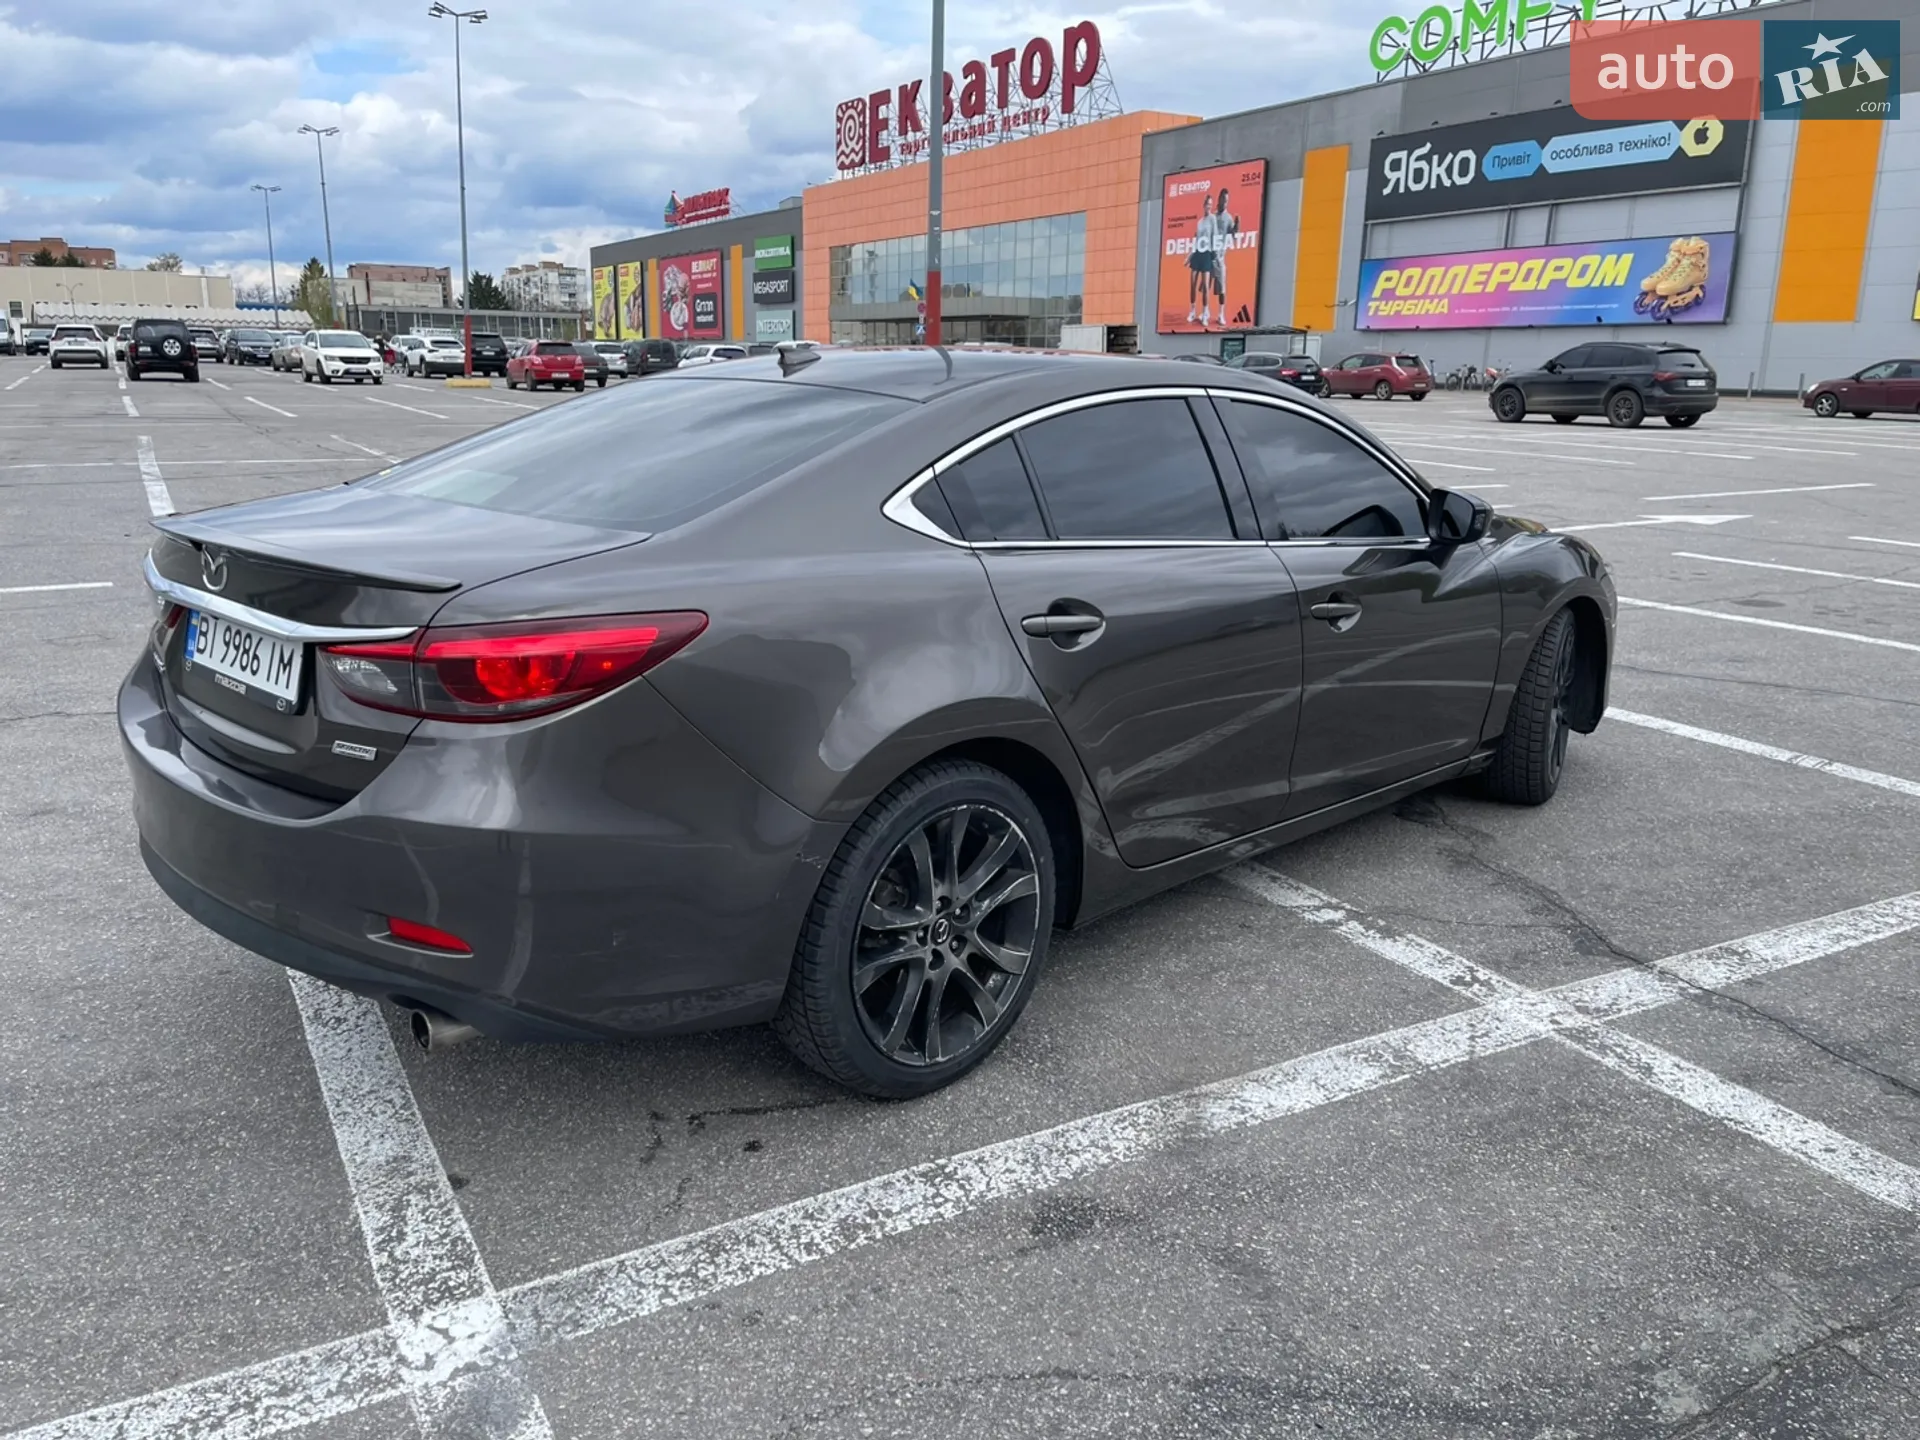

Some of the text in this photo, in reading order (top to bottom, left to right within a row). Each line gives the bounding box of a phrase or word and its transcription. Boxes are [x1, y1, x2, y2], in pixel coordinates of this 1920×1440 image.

[1002, 105, 1050, 132] центр
[1492, 151, 1532, 170] Привіт
[1550, 132, 1672, 161] особлива техніко!
[1382, 142, 1477, 196] Ябко
[753, 280, 789, 294] MEGASPORT
[1371, 253, 1635, 298] РОЛЛЕРДРОМ
[220, 625, 263, 676] 9986
